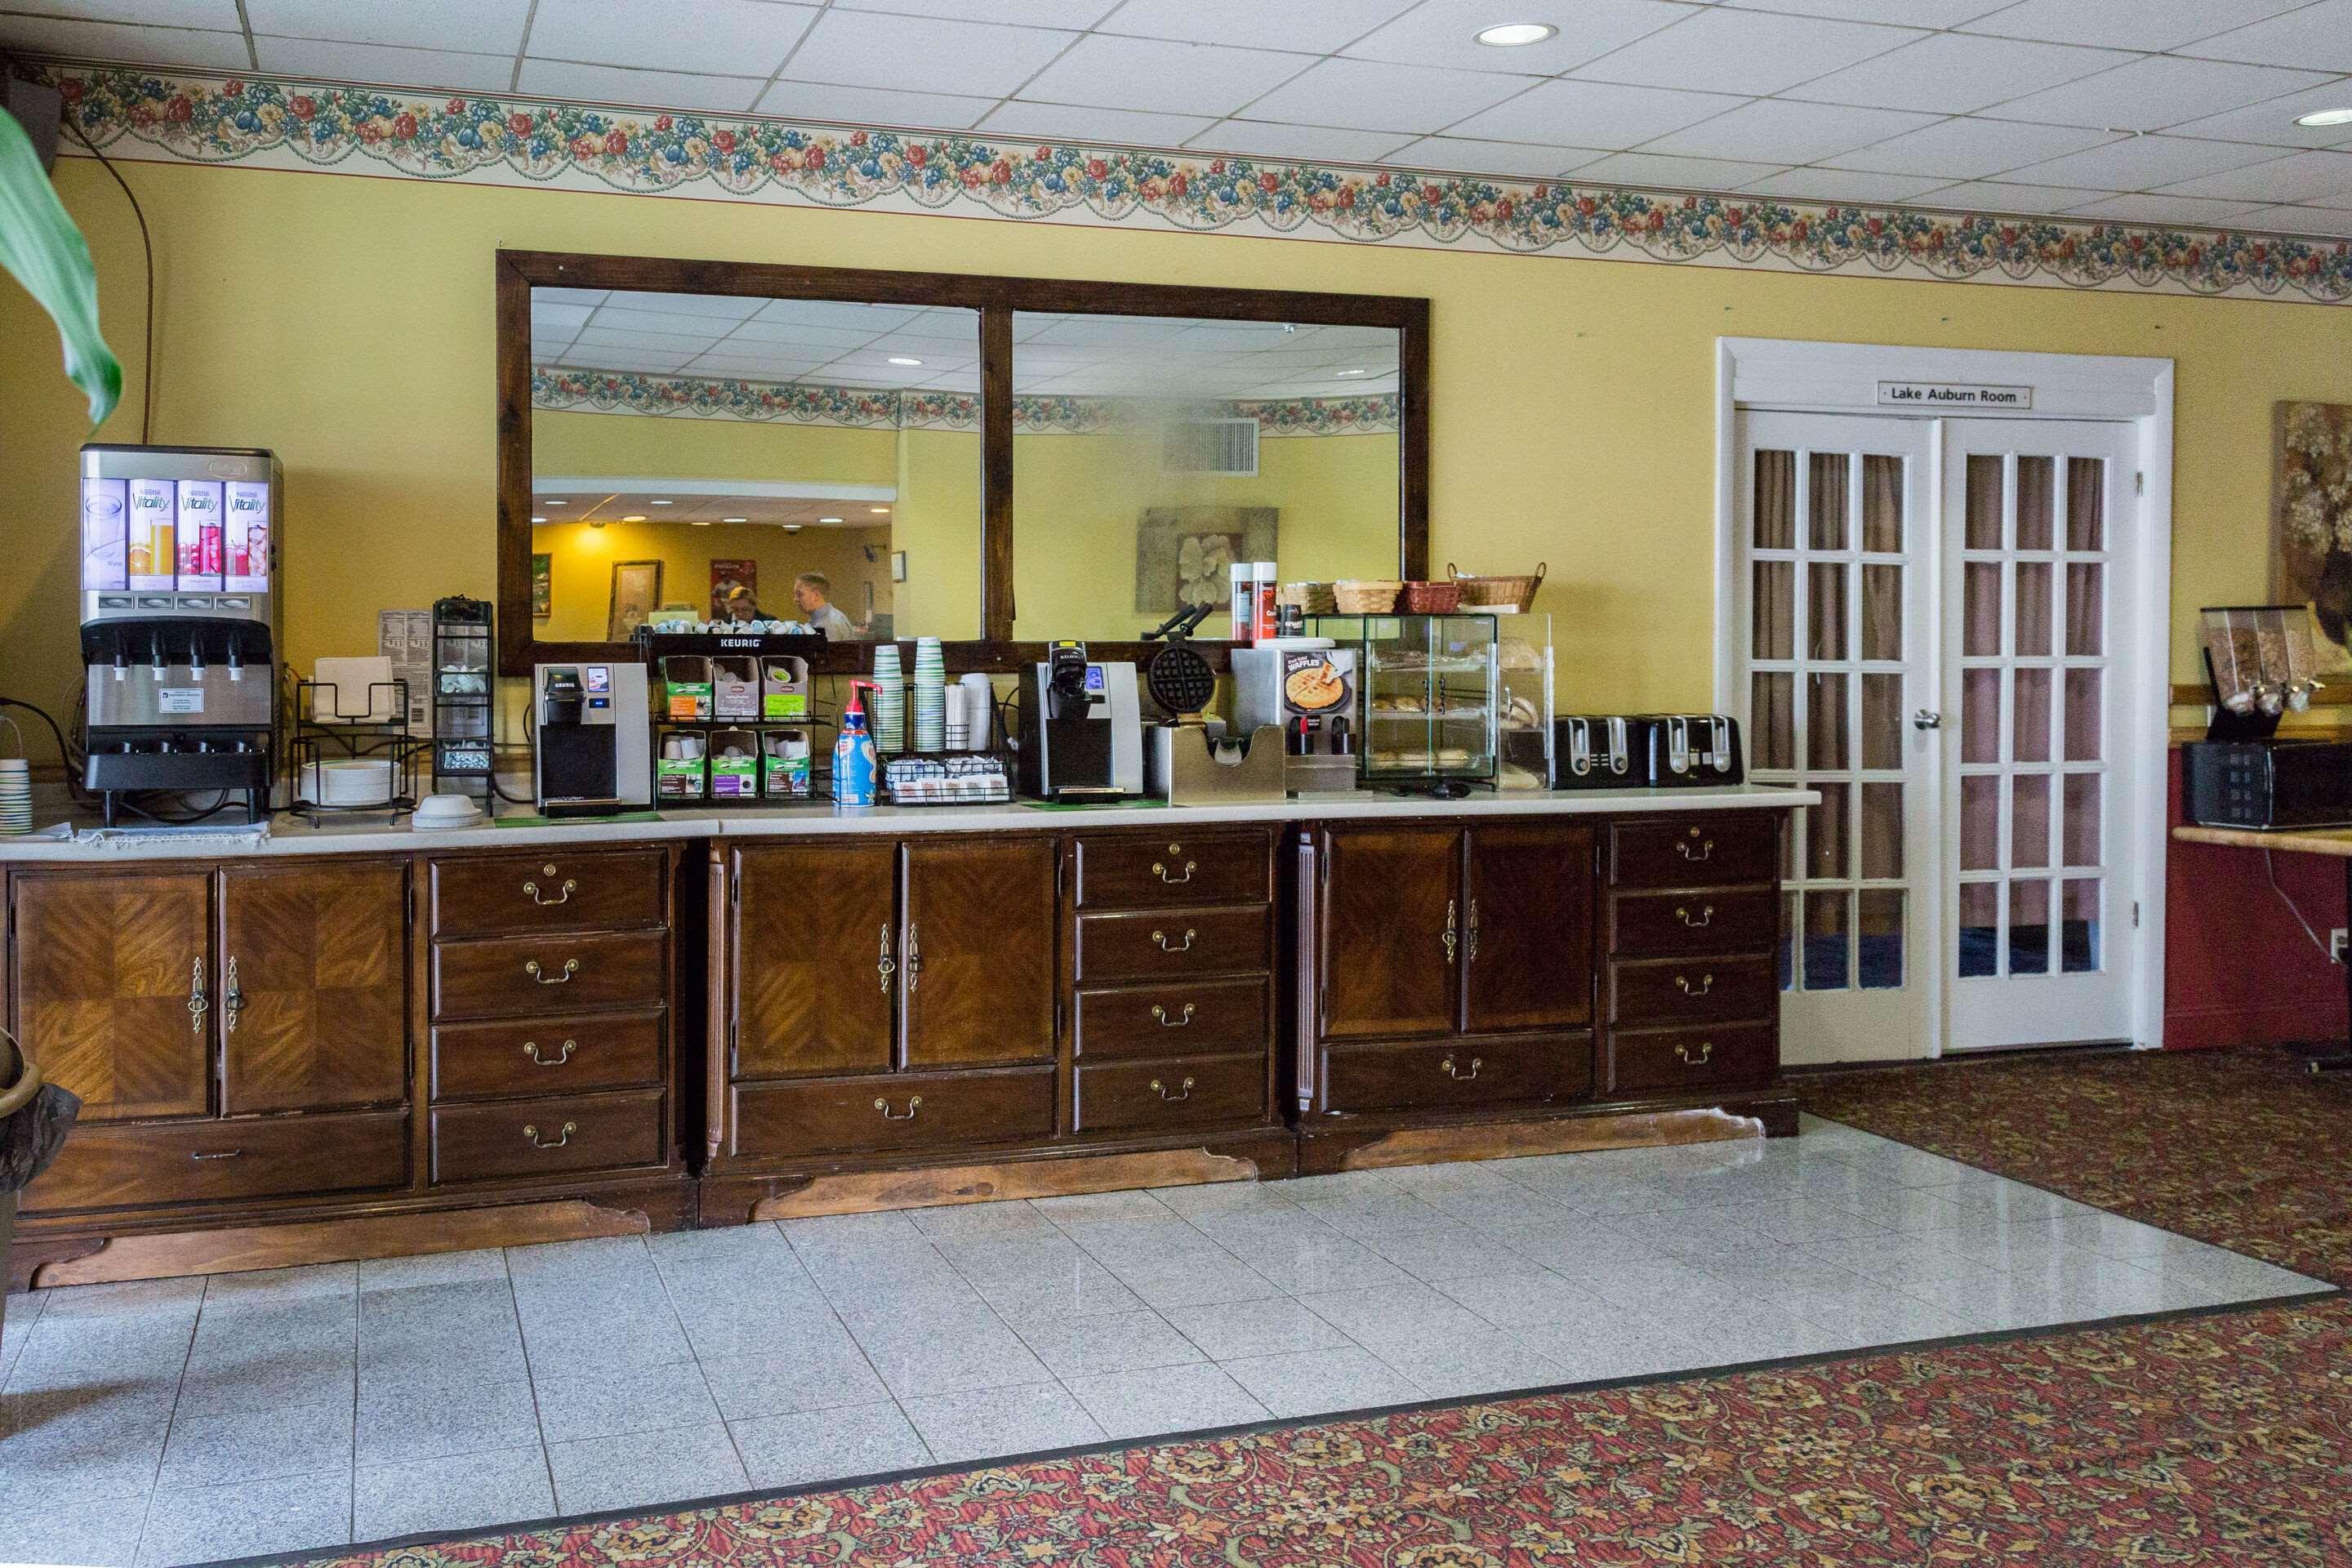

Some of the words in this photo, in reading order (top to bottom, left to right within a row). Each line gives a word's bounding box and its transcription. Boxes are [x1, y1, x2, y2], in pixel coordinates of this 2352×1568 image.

[1891, 387, 1922, 399] Lake
[1927, 389, 1975, 401] Auburn
[1980, 390, 2016, 403] Room
[132, 492, 170, 512] Vitality
[180, 493, 219, 513] Vitality
[229, 494, 265, 514] Vitality
[720, 639, 760, 648] KEURIG
[1288, 659, 1320, 670] WAFFLES
